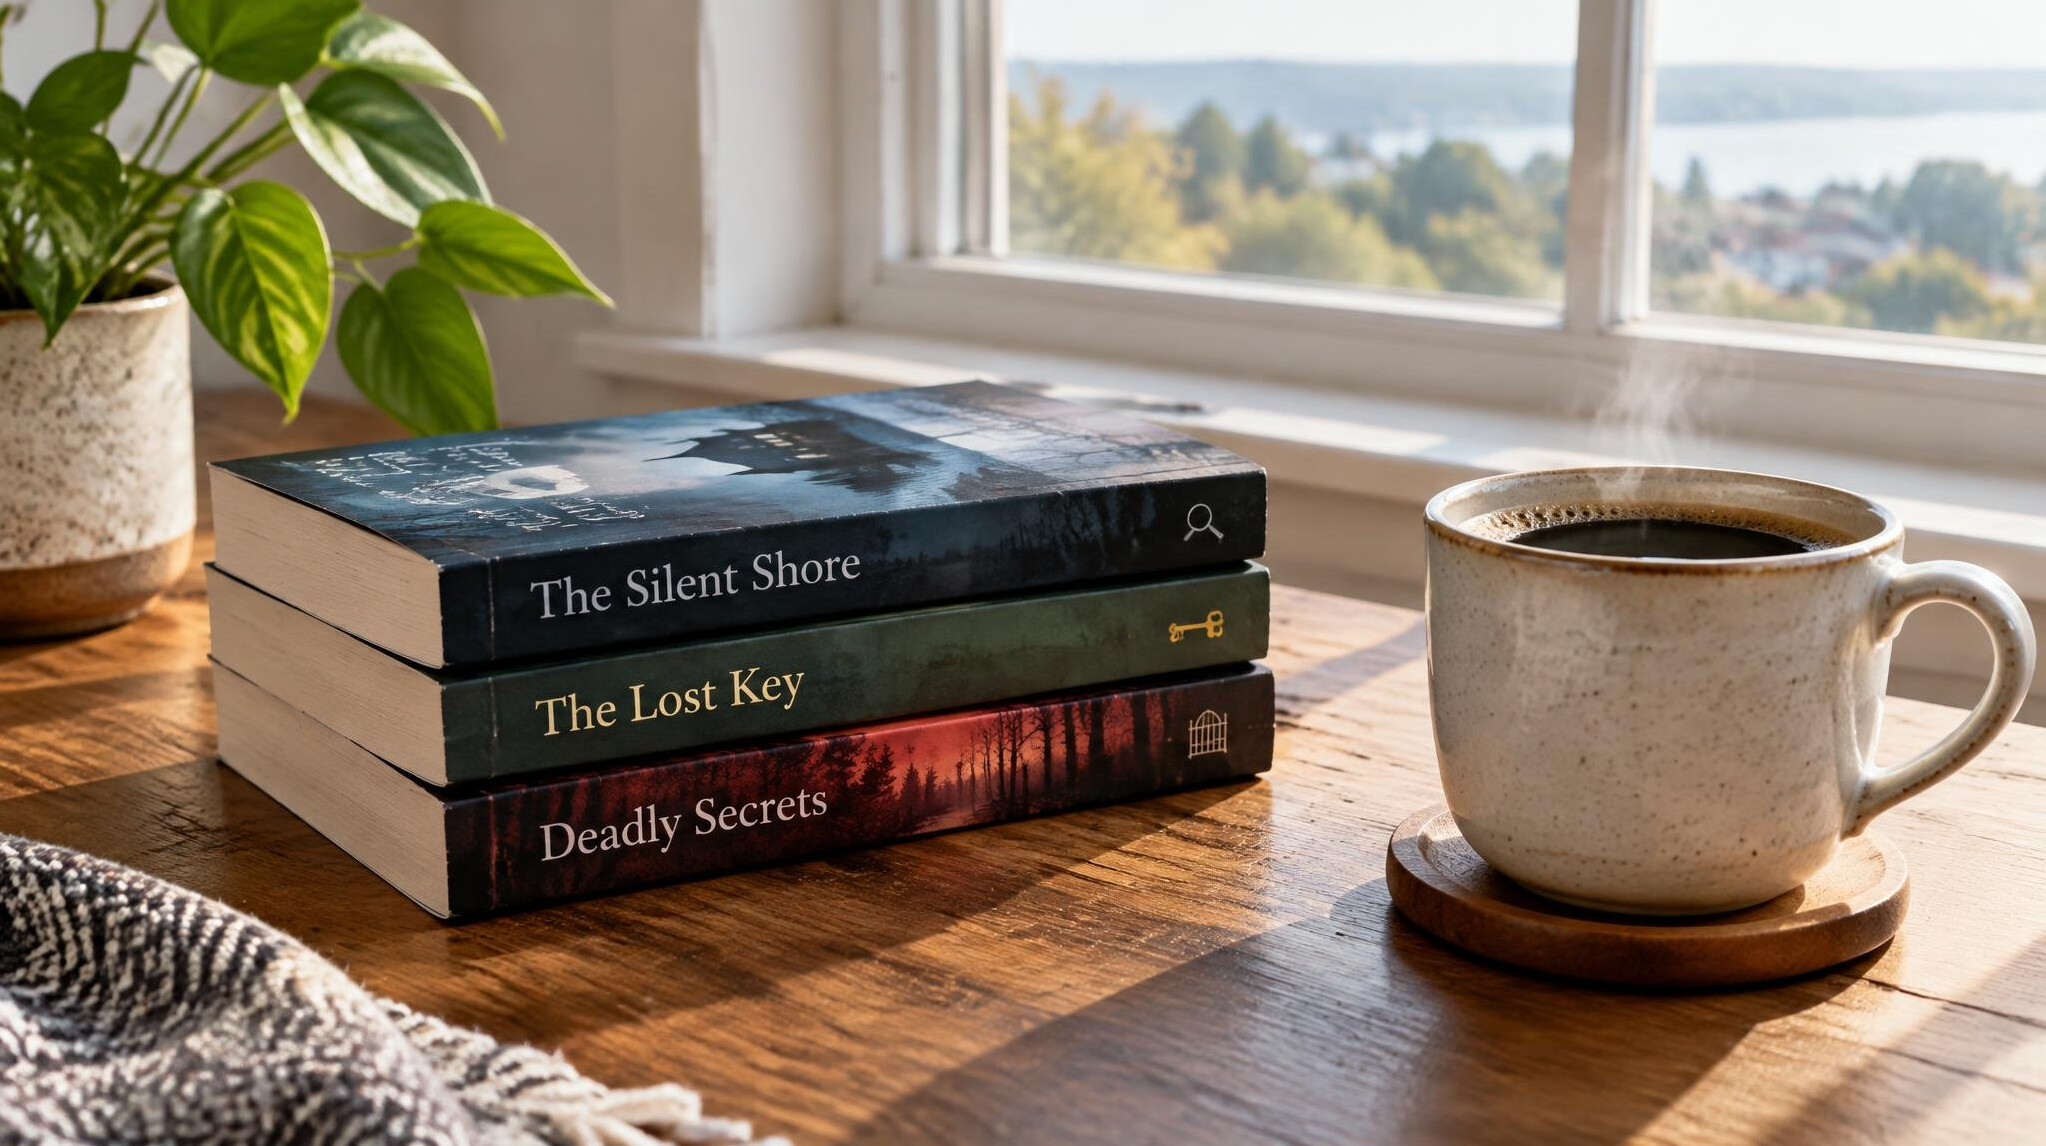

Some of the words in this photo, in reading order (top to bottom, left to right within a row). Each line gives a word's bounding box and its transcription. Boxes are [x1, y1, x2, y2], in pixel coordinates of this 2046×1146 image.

[530, 575, 612, 619] The
[626, 564, 739, 607] Silent
[752, 550, 861, 591] Shore
[535, 693, 617, 736] The
[629, 680, 717, 722] Lost
[729, 667, 805, 710] Key
[540, 804, 682, 861] Deadly
[695, 788, 828, 835] Secrets
